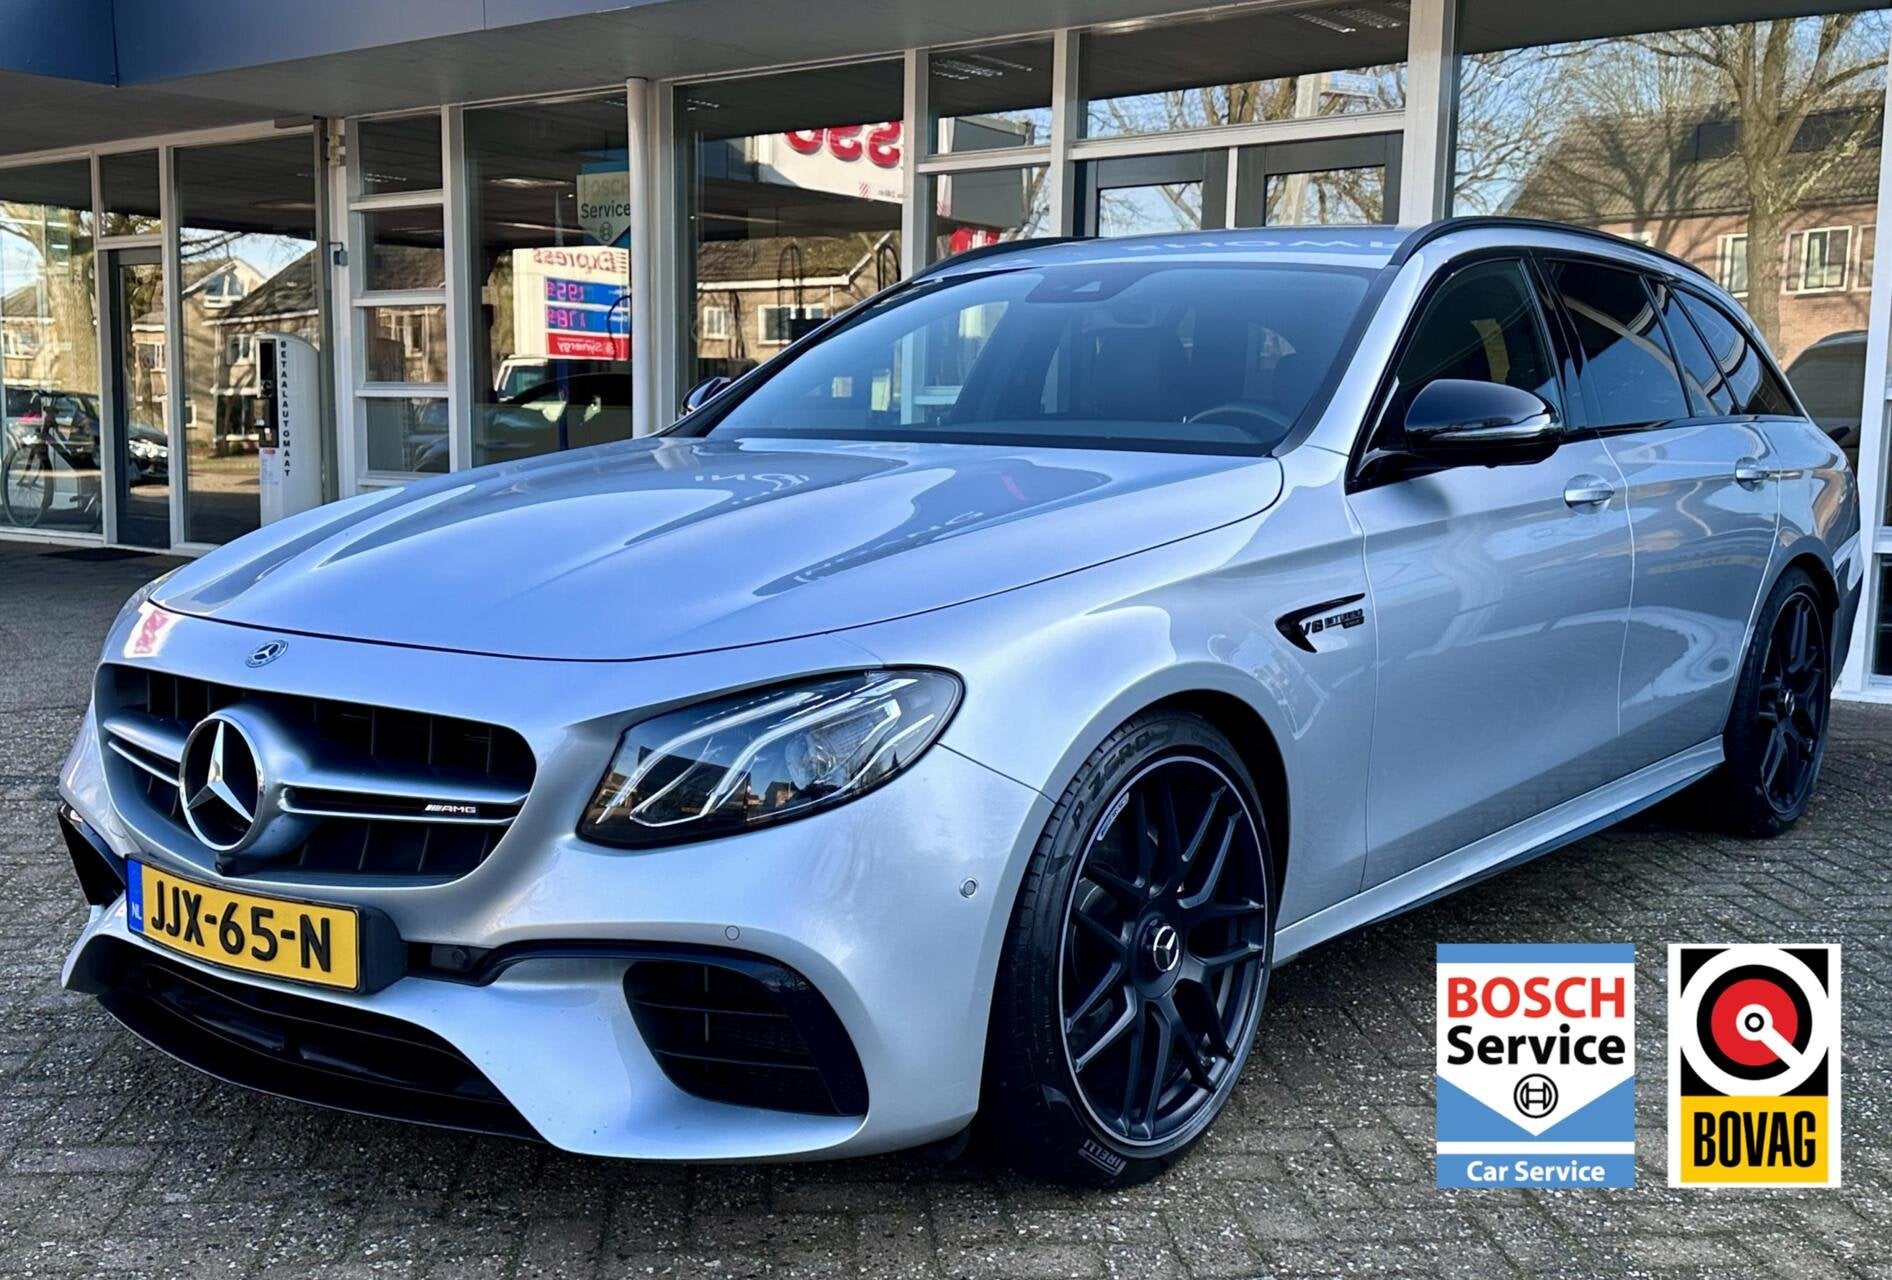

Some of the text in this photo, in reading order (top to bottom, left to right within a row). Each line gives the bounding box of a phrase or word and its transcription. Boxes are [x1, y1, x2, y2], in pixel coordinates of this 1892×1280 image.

[580, 200, 631, 220] Service
[280, 340, 291, 477] BETAALAUTOMAAT
[131, 901, 143, 921] NL
[151, 879, 332, 973] JJX-65-N
